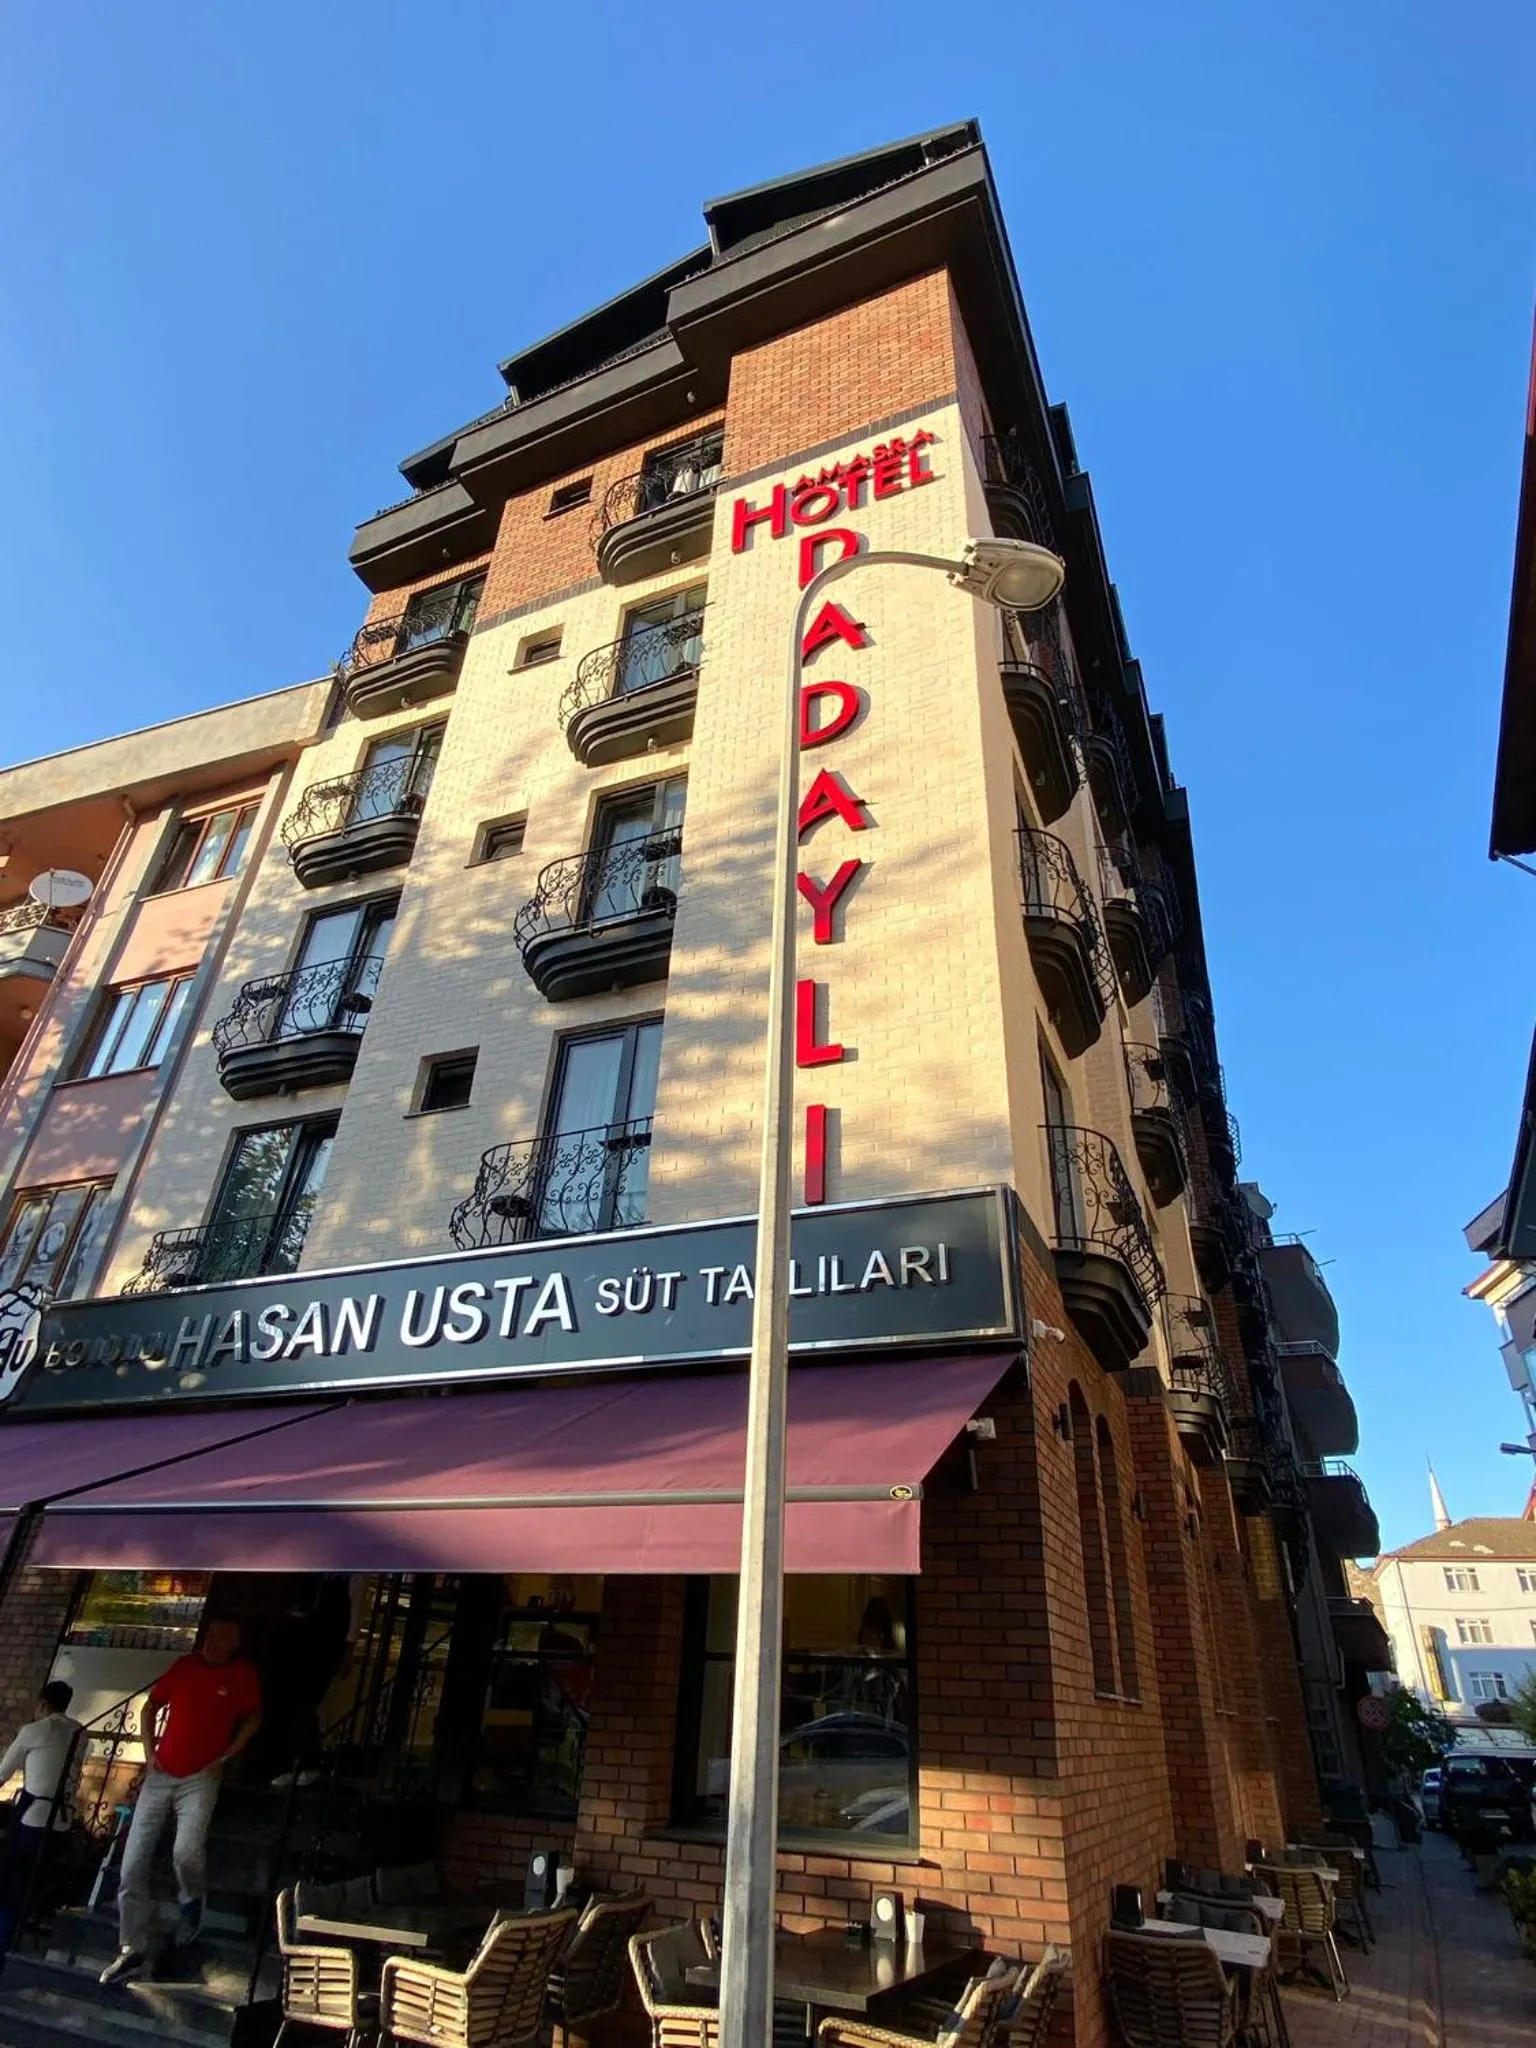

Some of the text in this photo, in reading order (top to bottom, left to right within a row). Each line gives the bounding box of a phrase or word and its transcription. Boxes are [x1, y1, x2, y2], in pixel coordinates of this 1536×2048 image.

[732, 449, 934, 554] HOTEL
[792, 429, 935, 496] AMASRA
[797, 528, 867, 1205] DADAYLI
[168, 1294, 378, 1368] HASAN
[400, 1272, 573, 1346] USTA
[595, 1266, 681, 1314] SÜT
[699, 1243, 948, 1304] TALILARI
